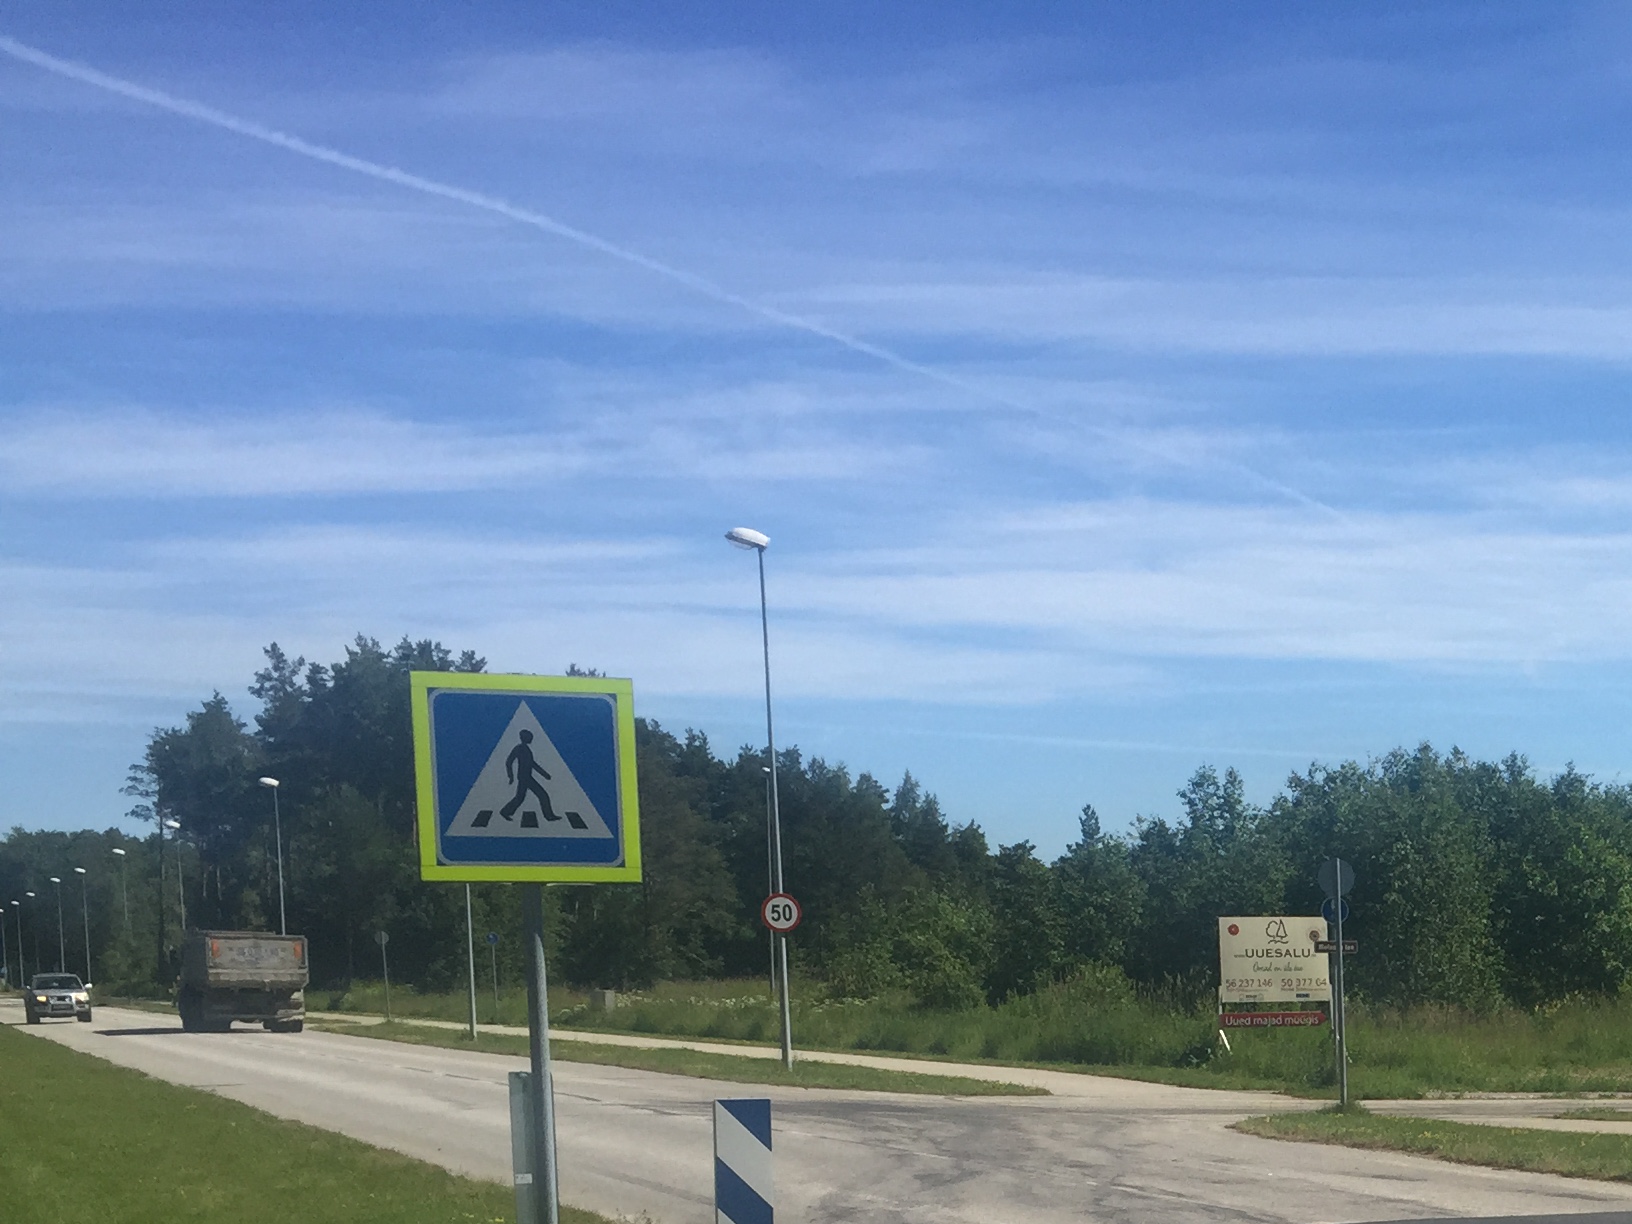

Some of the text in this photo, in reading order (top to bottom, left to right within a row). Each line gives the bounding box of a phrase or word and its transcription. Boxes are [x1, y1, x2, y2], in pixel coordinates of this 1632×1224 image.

[771, 903, 792, 922] 50
[1245, 948, 1311, 958] UUESALU
[1238, 978, 1255, 988] 237
[1281, 977, 1293, 987] 50
[1225, 1015, 1251, 1026] Uued
[1253, 1014, 1283, 1027] majad
